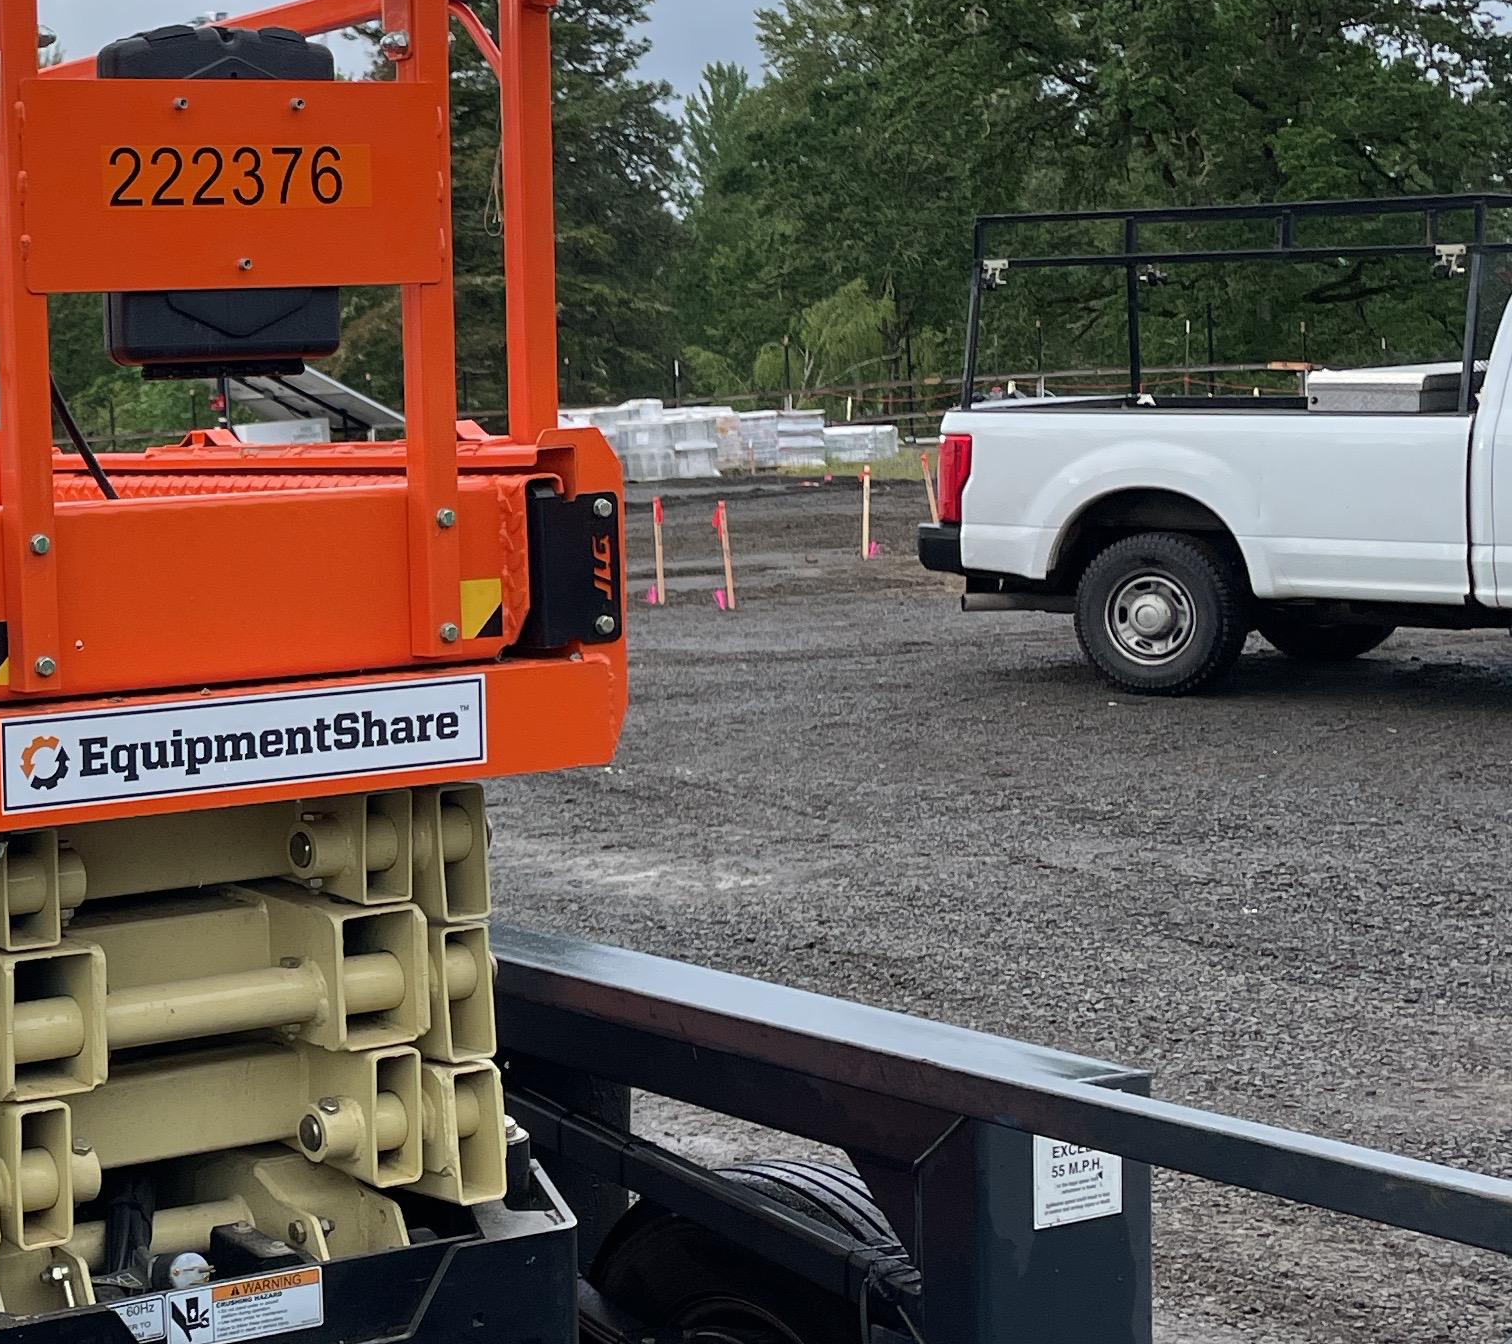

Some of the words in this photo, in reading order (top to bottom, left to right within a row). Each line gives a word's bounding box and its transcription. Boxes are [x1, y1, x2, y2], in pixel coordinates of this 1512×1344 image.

[108, 145, 344, 207] 222376
[592, 535, 613, 600] JLG
[79, 711, 459, 782] EquipmentShare
[1051, 1164, 1066, 1178] 55
[243, 1273, 302, 1295] WARNING
[253, 1290, 283, 1302] HAZARD
[126, 1301, 155, 1319] 60Hz
